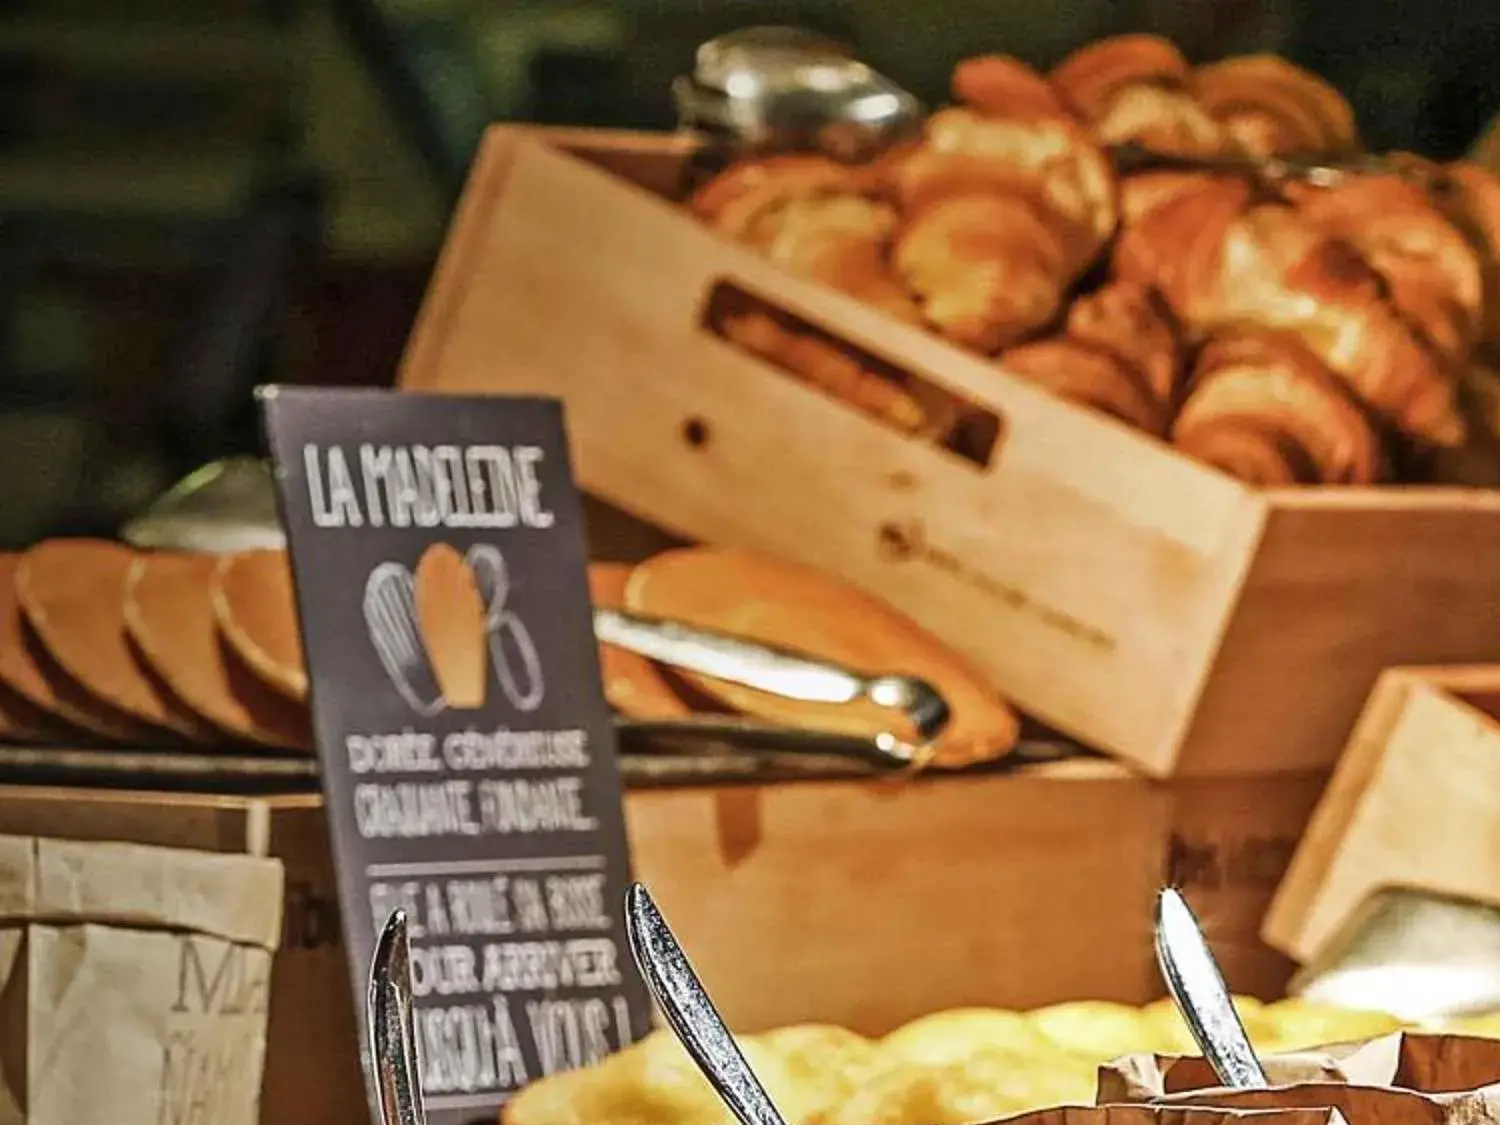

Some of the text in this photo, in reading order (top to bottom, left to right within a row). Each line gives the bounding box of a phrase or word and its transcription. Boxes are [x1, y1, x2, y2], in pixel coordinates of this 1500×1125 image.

[304, 443, 555, 528] LA MADELEINE
[411, 937, 622, 997] OUR ARRIVER
